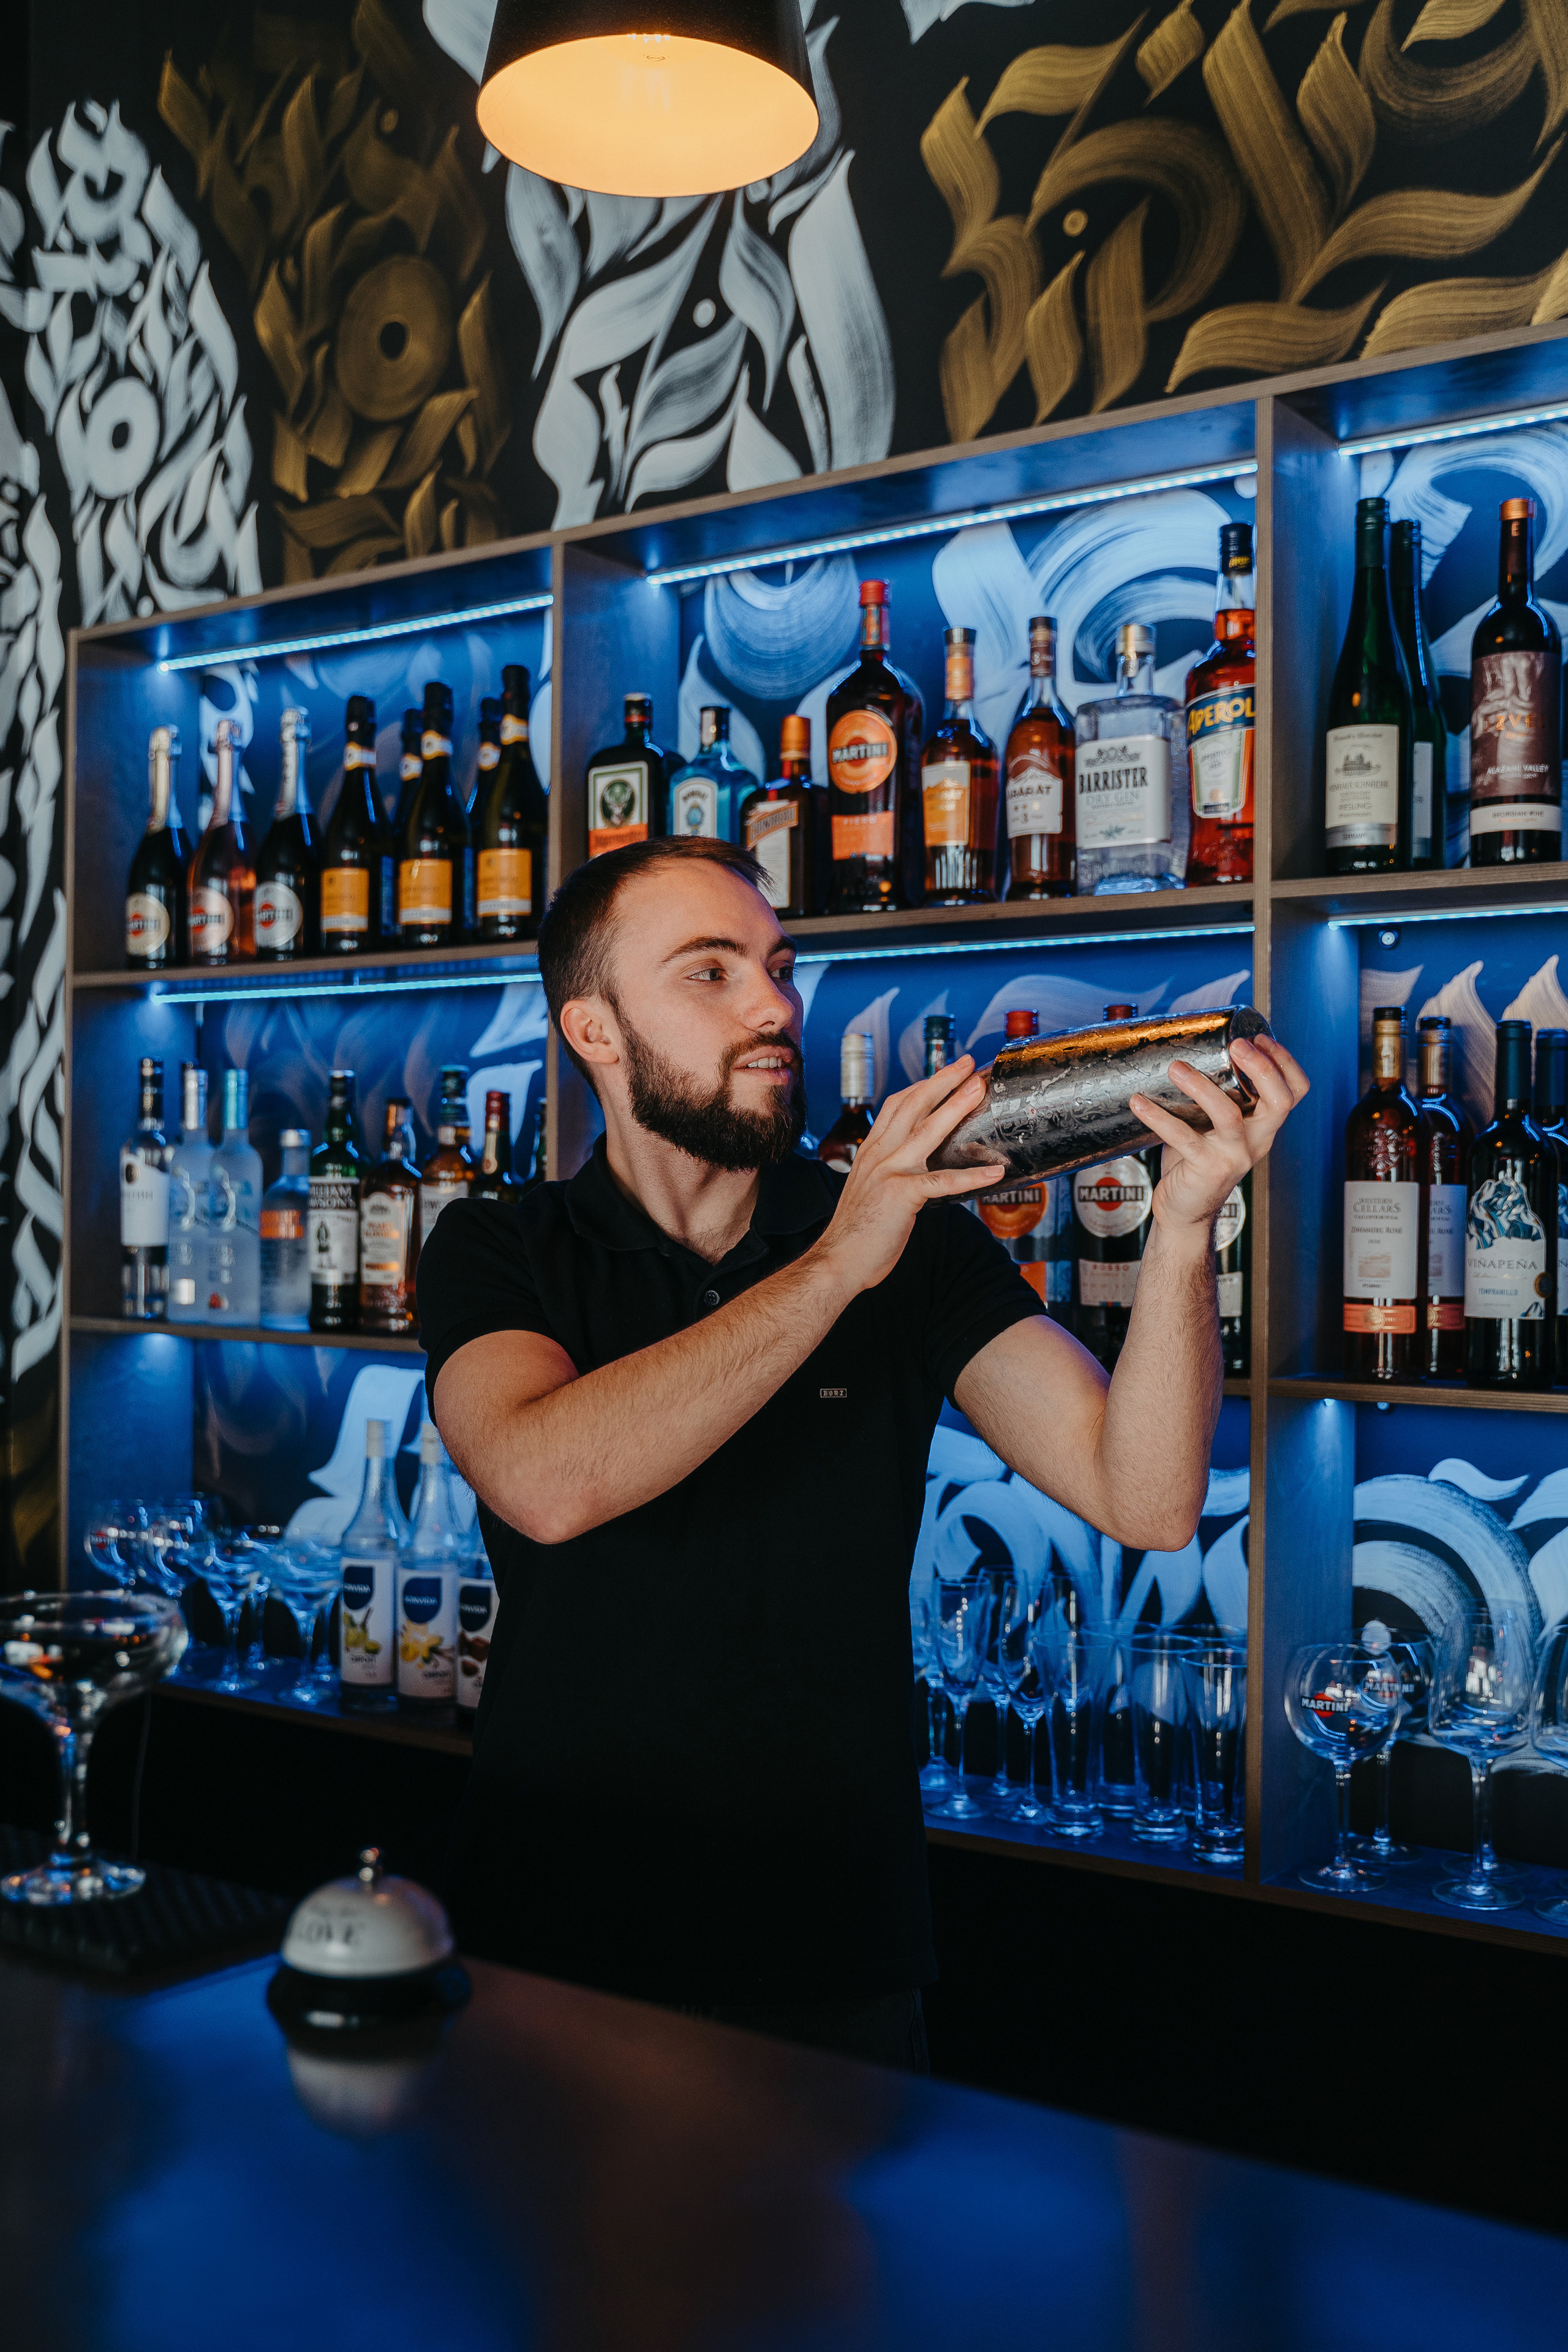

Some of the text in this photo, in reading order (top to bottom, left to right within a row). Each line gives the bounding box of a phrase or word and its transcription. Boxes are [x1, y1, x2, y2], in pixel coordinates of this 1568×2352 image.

[1187, 697, 1254, 739] APEROL
[833, 743, 888, 763] MARTINI
[1079, 767, 1148, 794] BARRISTER
[1085, 794, 1110, 807] DRY
[1114, 790, 1140, 803] GIN
[982, 1188, 1040, 1204] MARTINI
[1079, 1186, 1142, 1201] MARTINI
[1353, 1202, 1401, 1214] CELLARS
[1468, 1257, 1538, 1270] VIÑAPEÑA
[1301, 1697, 1350, 1713] MARTINI
